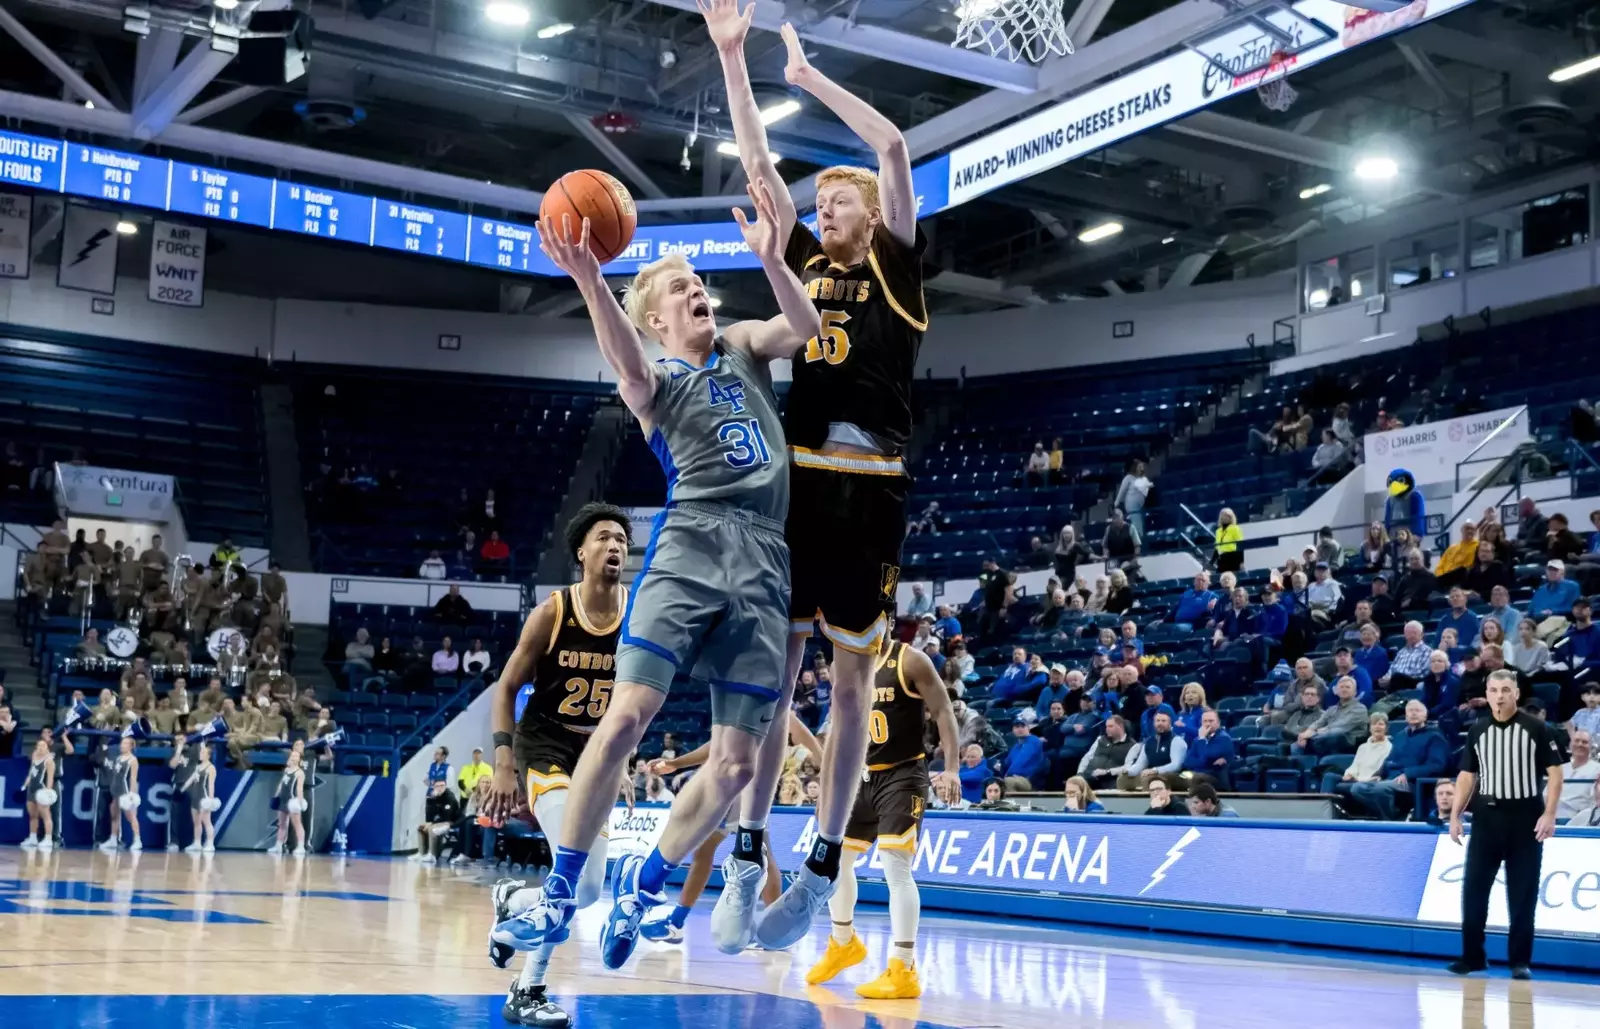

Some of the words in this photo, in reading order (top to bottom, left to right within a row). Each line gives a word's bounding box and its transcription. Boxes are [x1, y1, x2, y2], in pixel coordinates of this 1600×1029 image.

[953, 129, 1064, 191] AWARD-WINNING
[1066, 106, 1115, 143] CHEESE
[1117, 83, 1171, 123] STEAKS
[31, 142, 58, 162] LEFT
[4, 161, 42, 183] FOULS
[104, 168, 122, 183] PTS
[124, 171, 132, 185] 0
[202, 170, 228, 187] Taylor
[103, 184, 120, 199] FLS
[123, 187, 131, 200] 0
[205, 186, 223, 201] PTS
[231, 190, 239, 204] 0
[204, 202, 220, 216] FLS
[230, 206, 238, 220] 0
[305, 204, 322, 218] PTS
[329, 207, 339, 221] 12
[170, 228, 191, 240] AIR
[304, 219, 319, 233] FLS
[328, 223, 336, 236] 0
[405, 222, 422, 236] PTS
[157, 240, 201, 258] FORCE
[405, 237, 420, 251] FLS
[436, 243, 443, 255] 2
[499, 239, 514, 252] PTS
[659, 241, 700, 257] Enjoy
[498, 254, 511, 267] FLS
[523, 258, 528, 270] 1
[156, 263, 199, 281] WNIT
[158, 286, 193, 301] 2022
[707, 376, 745, 414] AF
[1466, 416, 1518, 436] L3HARRS
[717, 418, 771, 467] 31
[1391, 430, 1437, 449] L3HARRIS
[98, 474, 168, 494] centura
[558, 650, 616, 671] COWBO
[557, 677, 615, 718] 25
[614, 810, 658, 832] Jacobs
[968, 831, 1109, 884] ARENA
